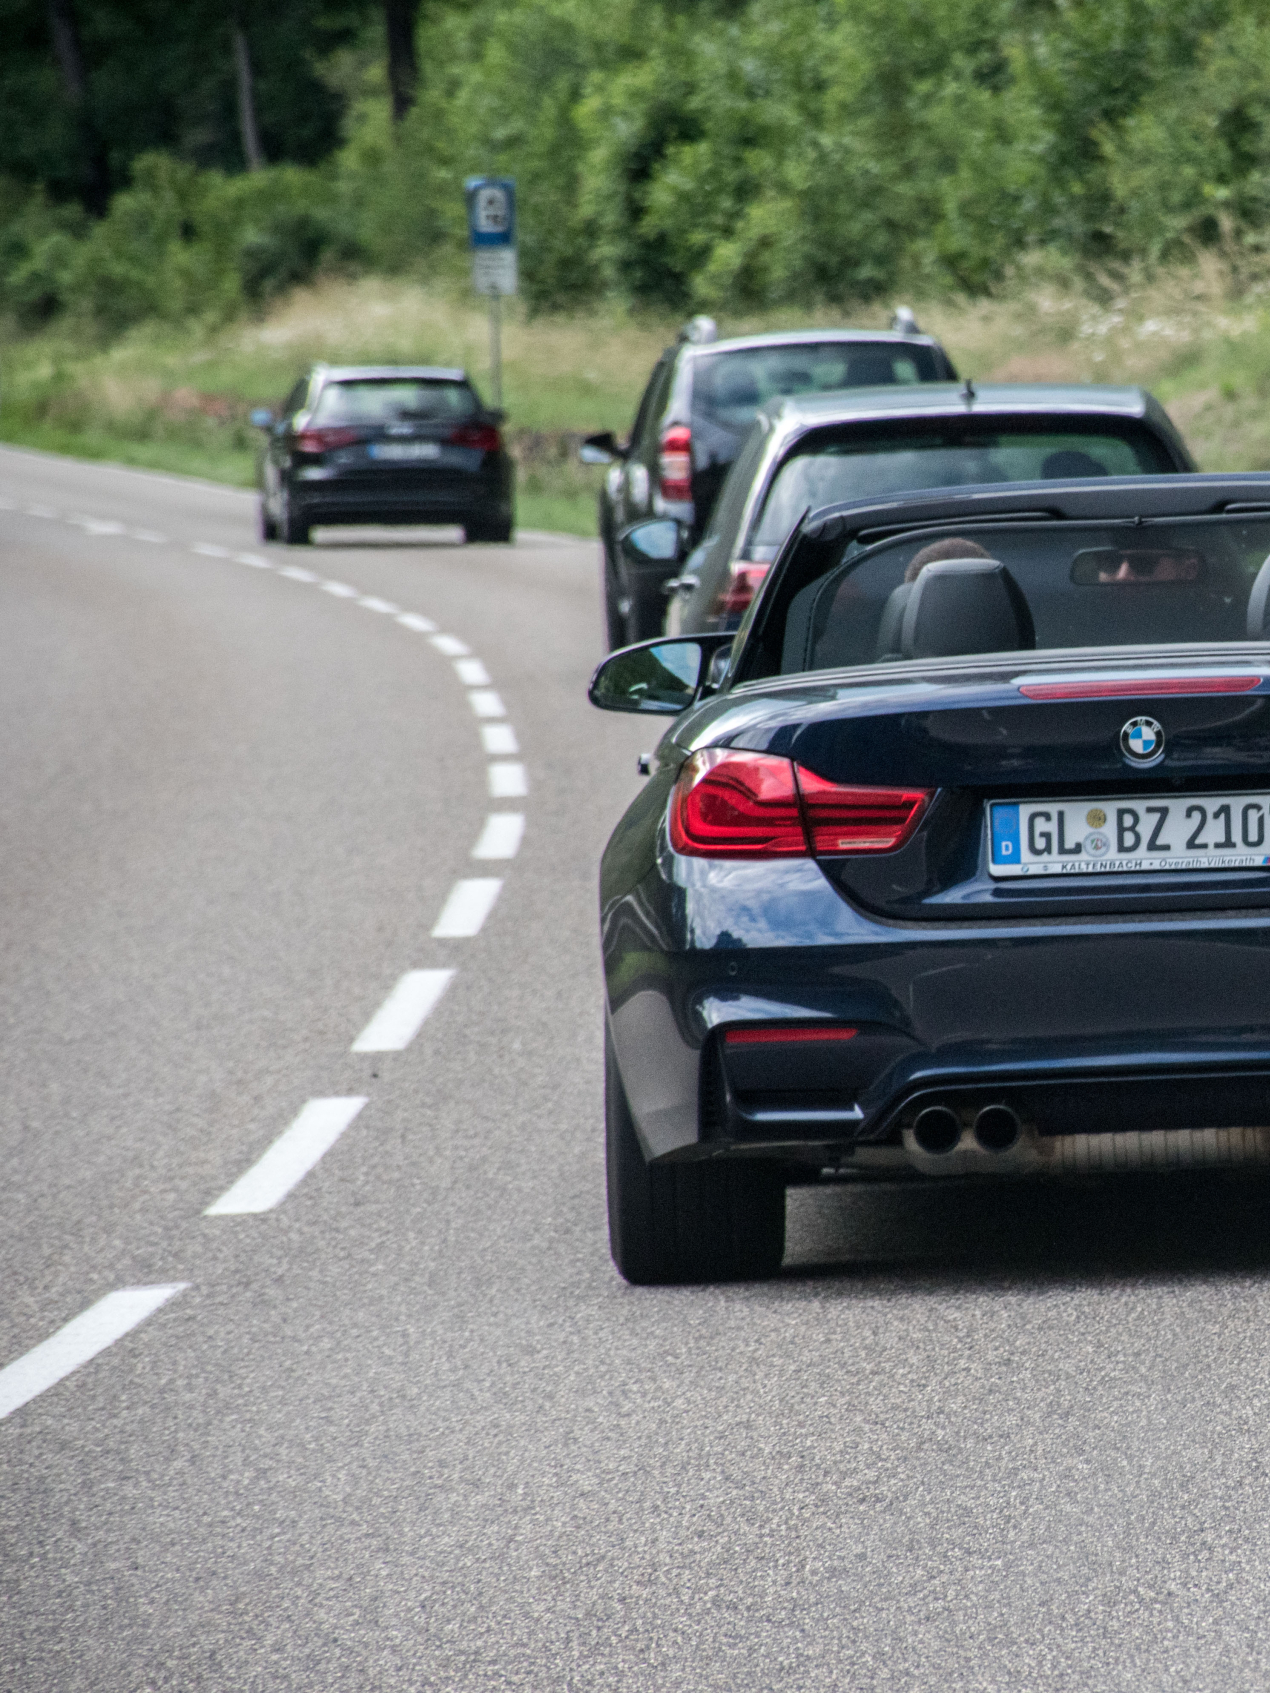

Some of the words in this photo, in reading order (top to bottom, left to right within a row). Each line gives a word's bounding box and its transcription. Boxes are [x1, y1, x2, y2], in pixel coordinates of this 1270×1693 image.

[1001, 841, 1013, 855] D
[1027, 811, 1082, 856] GL
[1116, 806, 1171, 853] BZ
[1062, 860, 1143, 872] KALTENBACH
[1159, 856, 1255, 868] Overath-Vilkerath
